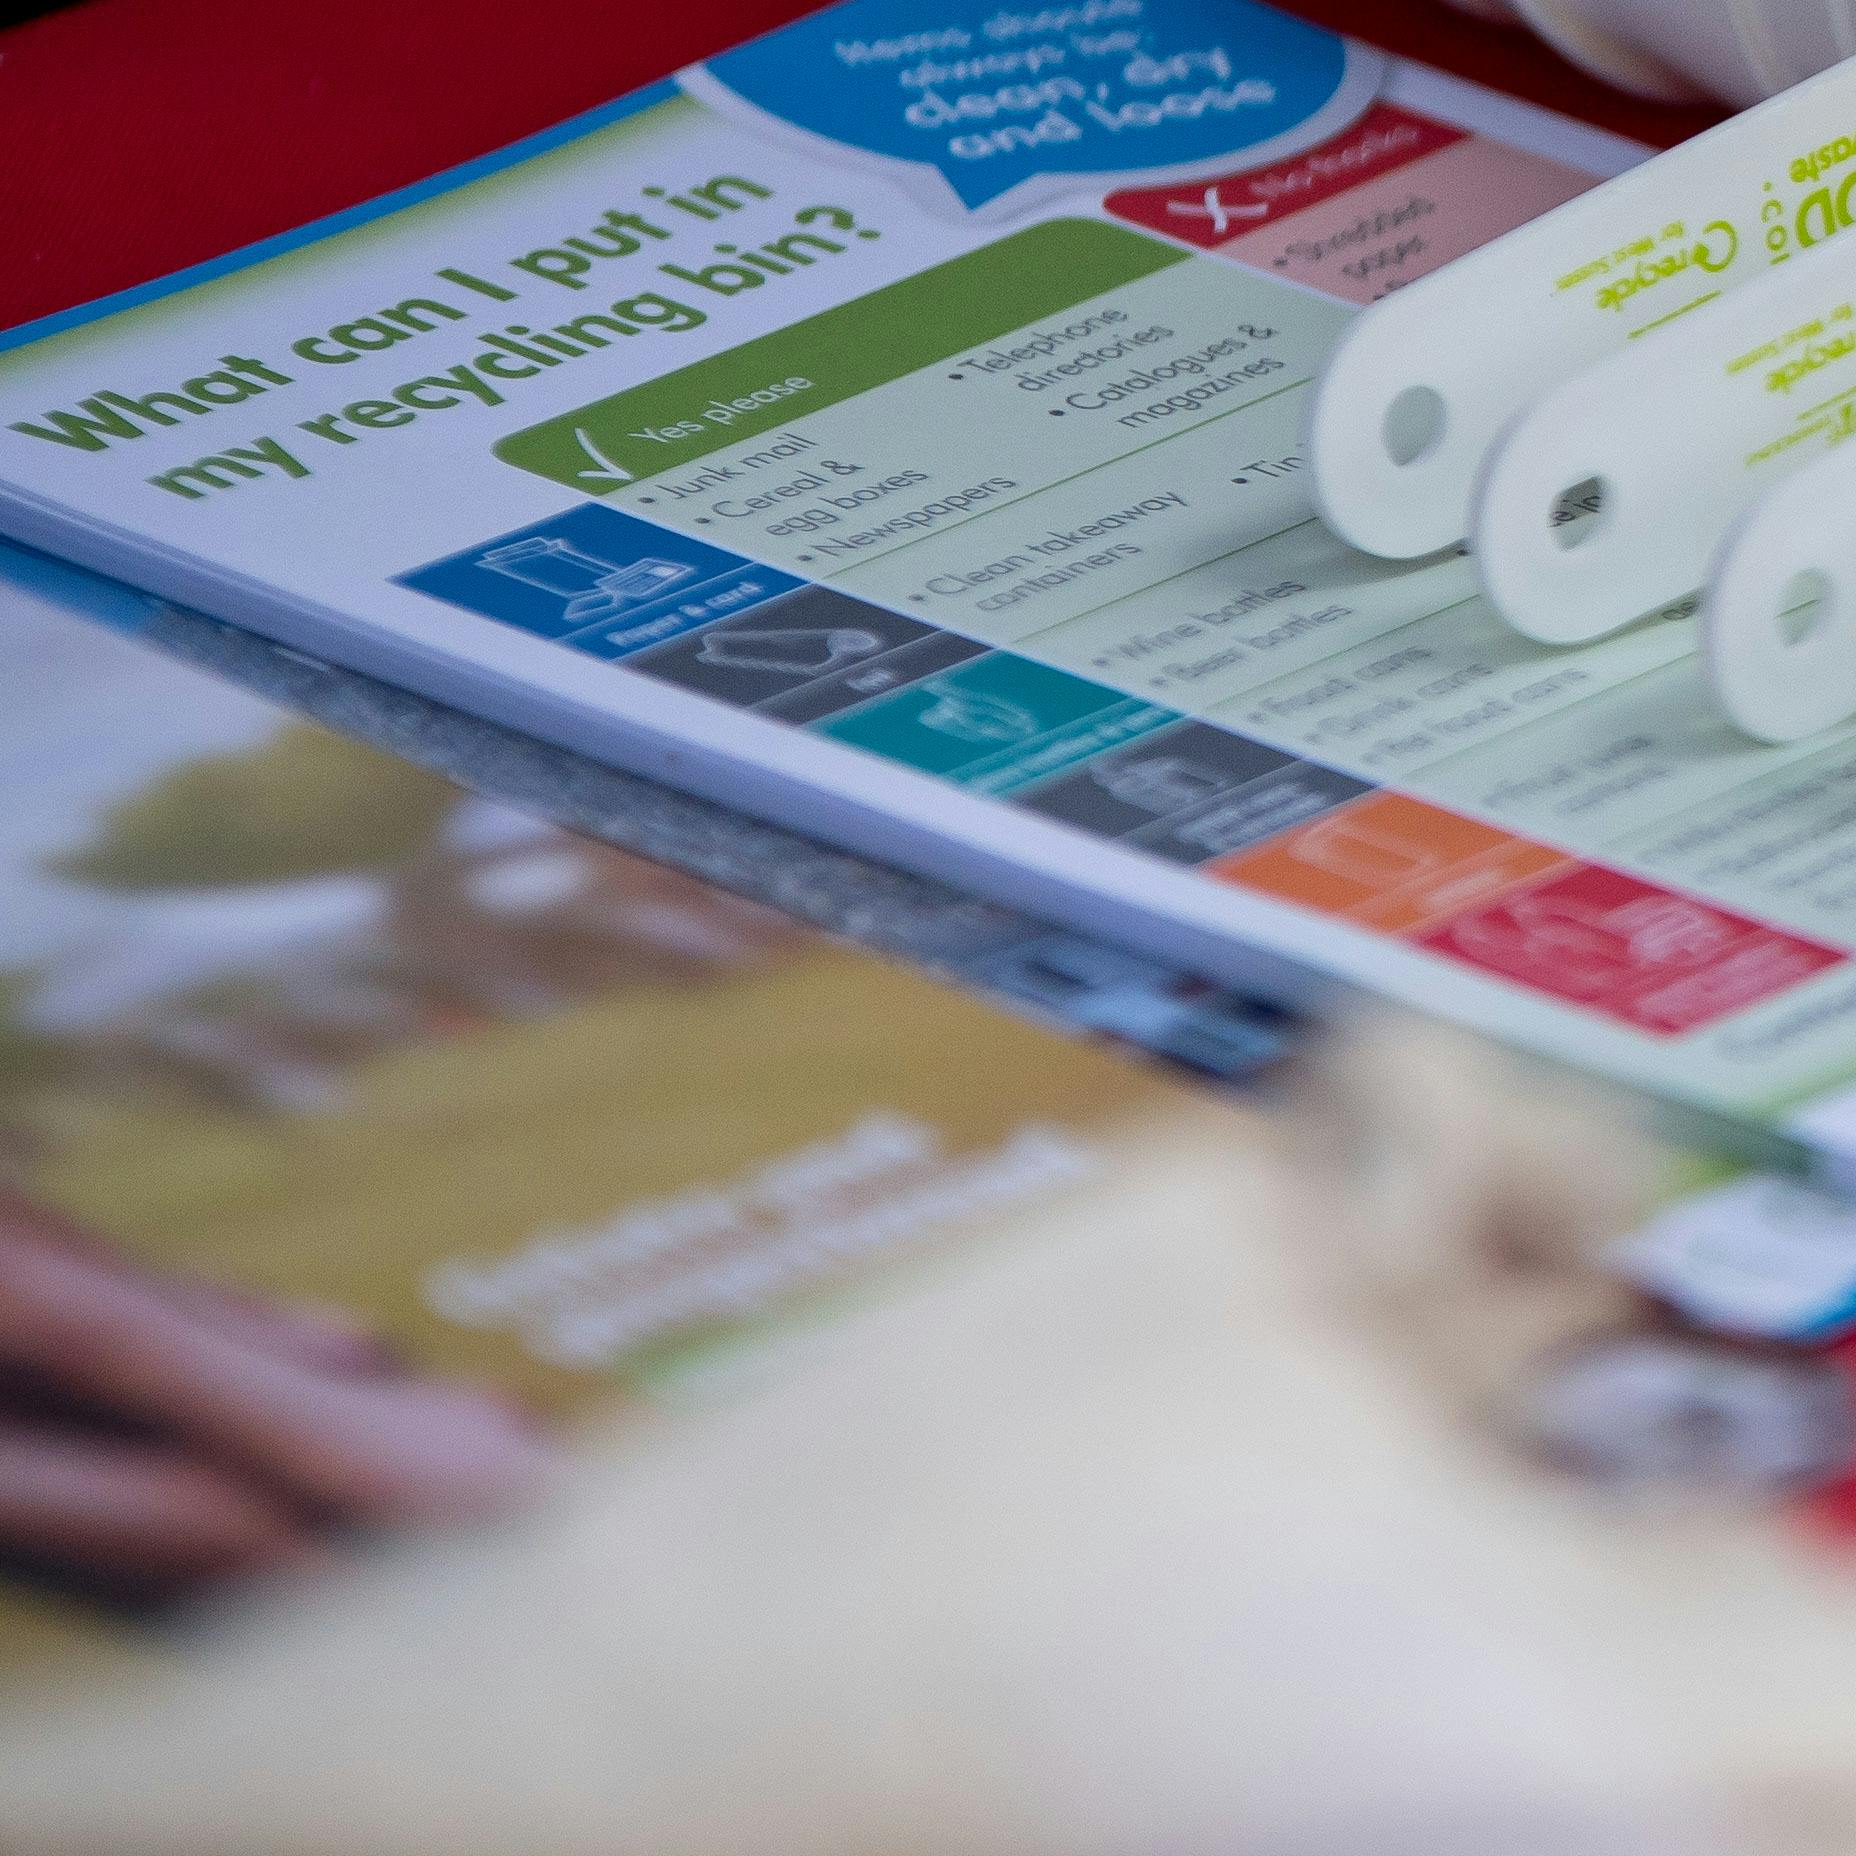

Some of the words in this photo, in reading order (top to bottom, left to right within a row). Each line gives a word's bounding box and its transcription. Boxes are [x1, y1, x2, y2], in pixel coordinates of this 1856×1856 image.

[1123, 45, 1232, 86] dry
[948, 109, 1083, 158] and
[1086, 78, 1277, 132] loose
[9, 353, 294, 452] What
[291, 294, 467, 365] can
[436, 267, 520, 302] I
[510, 205, 673, 290] put
[641, 172, 774, 220] in
[1597, 248, 1692, 312] recycle
[146, 433, 313, 501] my
[297, 286, 709, 447] recycling
[657, 204, 883, 297] bin?
[957, 308, 1129, 375] Telephone
[1017, 324, 1176, 392] directories
[1065, 336, 1248, 411] Catalogues
[1237, 324, 1280, 340] &
[627, 418, 706, 445] Yes
[701, 375, 818, 427] please
[1117, 354, 1286, 429] magazines
[655, 464, 746, 501] Junk
[740, 431, 821, 471] mail
[711, 469, 833, 519] Cereal
[819, 459, 866, 476] &
[1239, 455, 1305, 478] Tin
[766, 506, 842, 538] egg
[819, 469, 929, 511] boxes
[812, 474, 1018, 557] Newspapers
[925, 552, 1036, 597] Clean
[1026, 489, 1190, 557] takeaway
[975, 542, 1143, 611] containers
[1115, 622, 1203, 660] Wine
[1190, 580, 1307, 626] bottles
[1234, 603, 1355, 651] bottles
